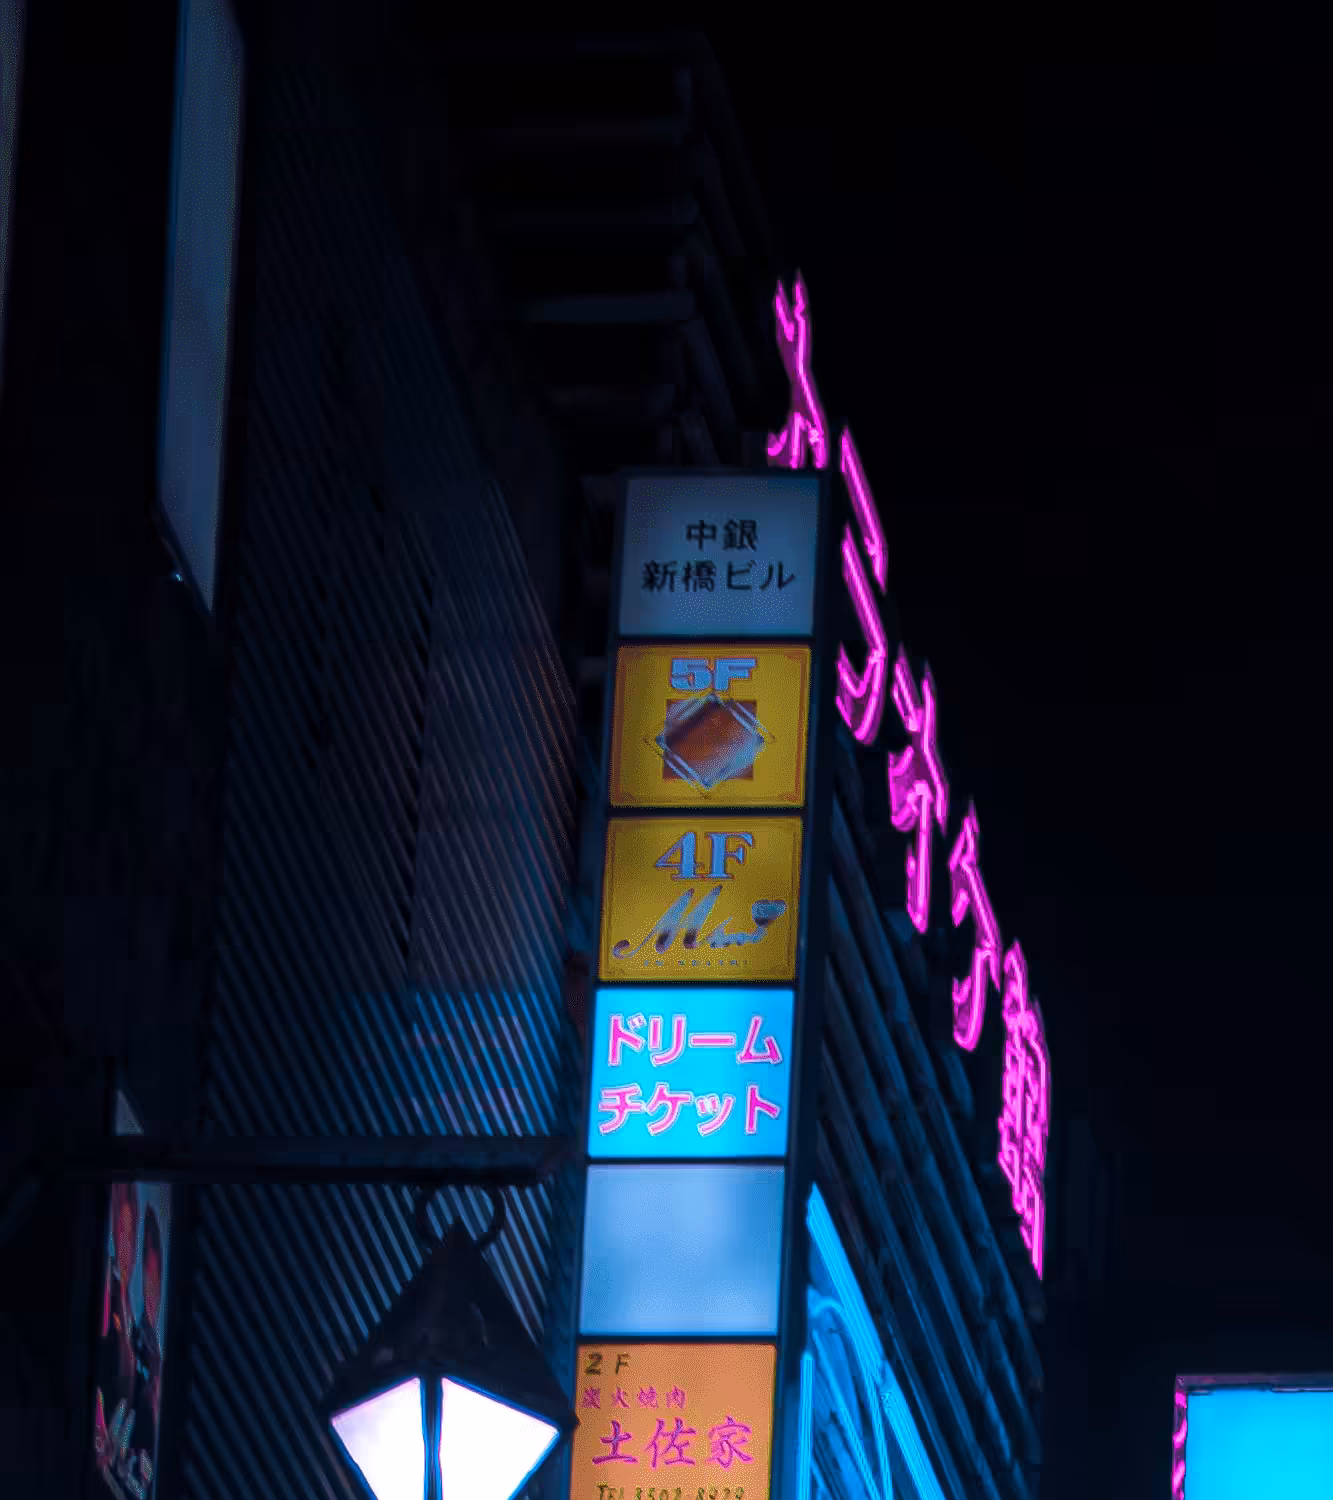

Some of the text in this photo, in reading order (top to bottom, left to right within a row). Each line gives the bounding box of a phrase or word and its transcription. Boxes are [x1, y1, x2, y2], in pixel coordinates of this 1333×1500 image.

[685, 519, 758, 551] 中銀
[641, 560, 796, 593] 新橋ビル
[671, 658, 757, 691] 5F
[655, 832, 755, 880] 4F
[605, 1014, 782, 1068] ドリーム
[598, 1083, 780, 1137] チケット
[584, 1353, 631, 1375] 2F
[592, 1415, 754, 1469] 土佐家
